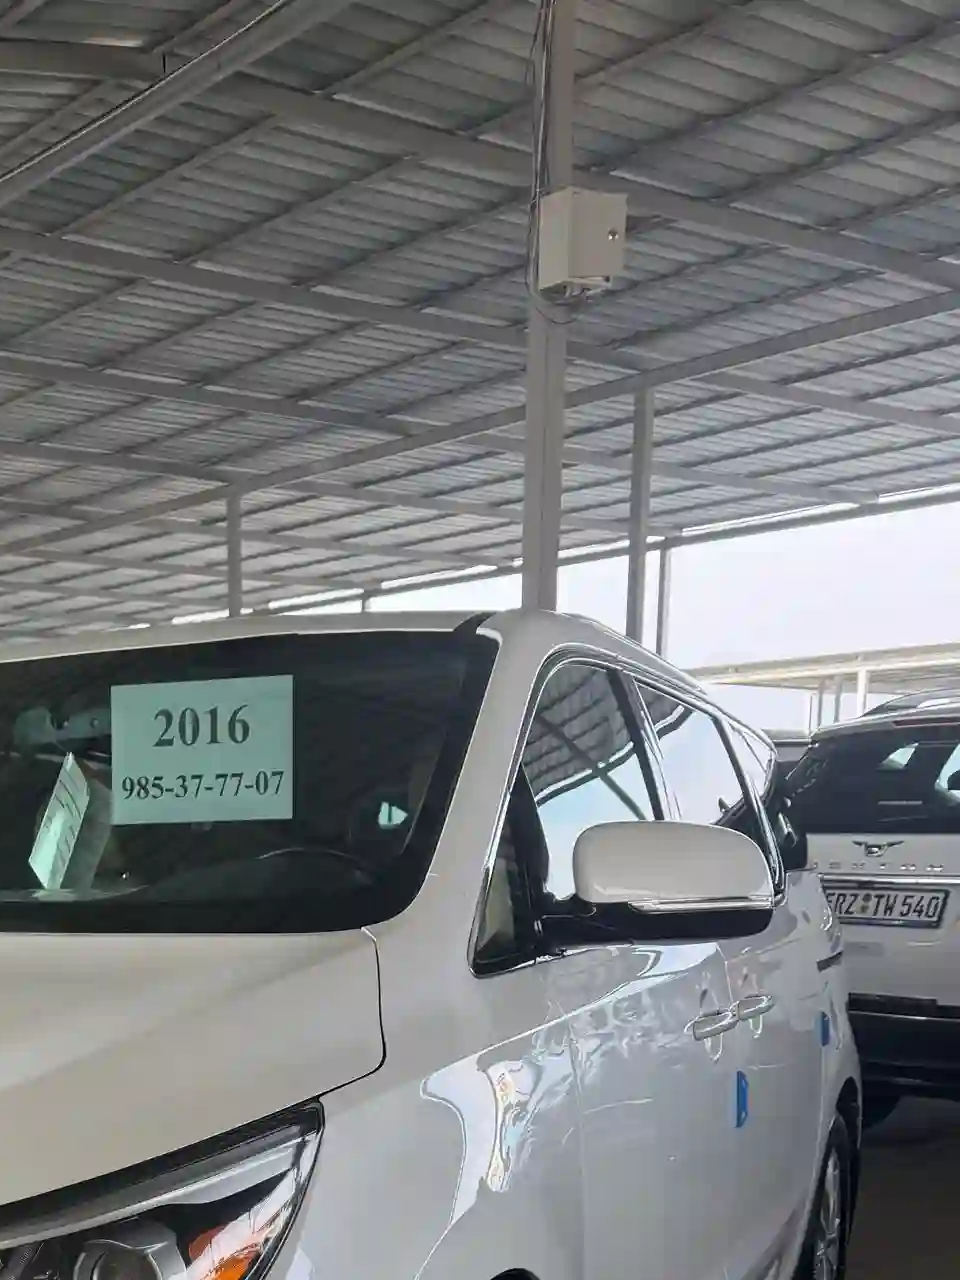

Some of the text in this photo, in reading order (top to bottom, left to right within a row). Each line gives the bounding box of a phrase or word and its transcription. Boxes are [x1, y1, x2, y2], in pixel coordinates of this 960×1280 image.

[151, 704, 251, 748] 2016
[121, 770, 285, 800] 985-37-77-07
[900, 895, 941, 918] 540
